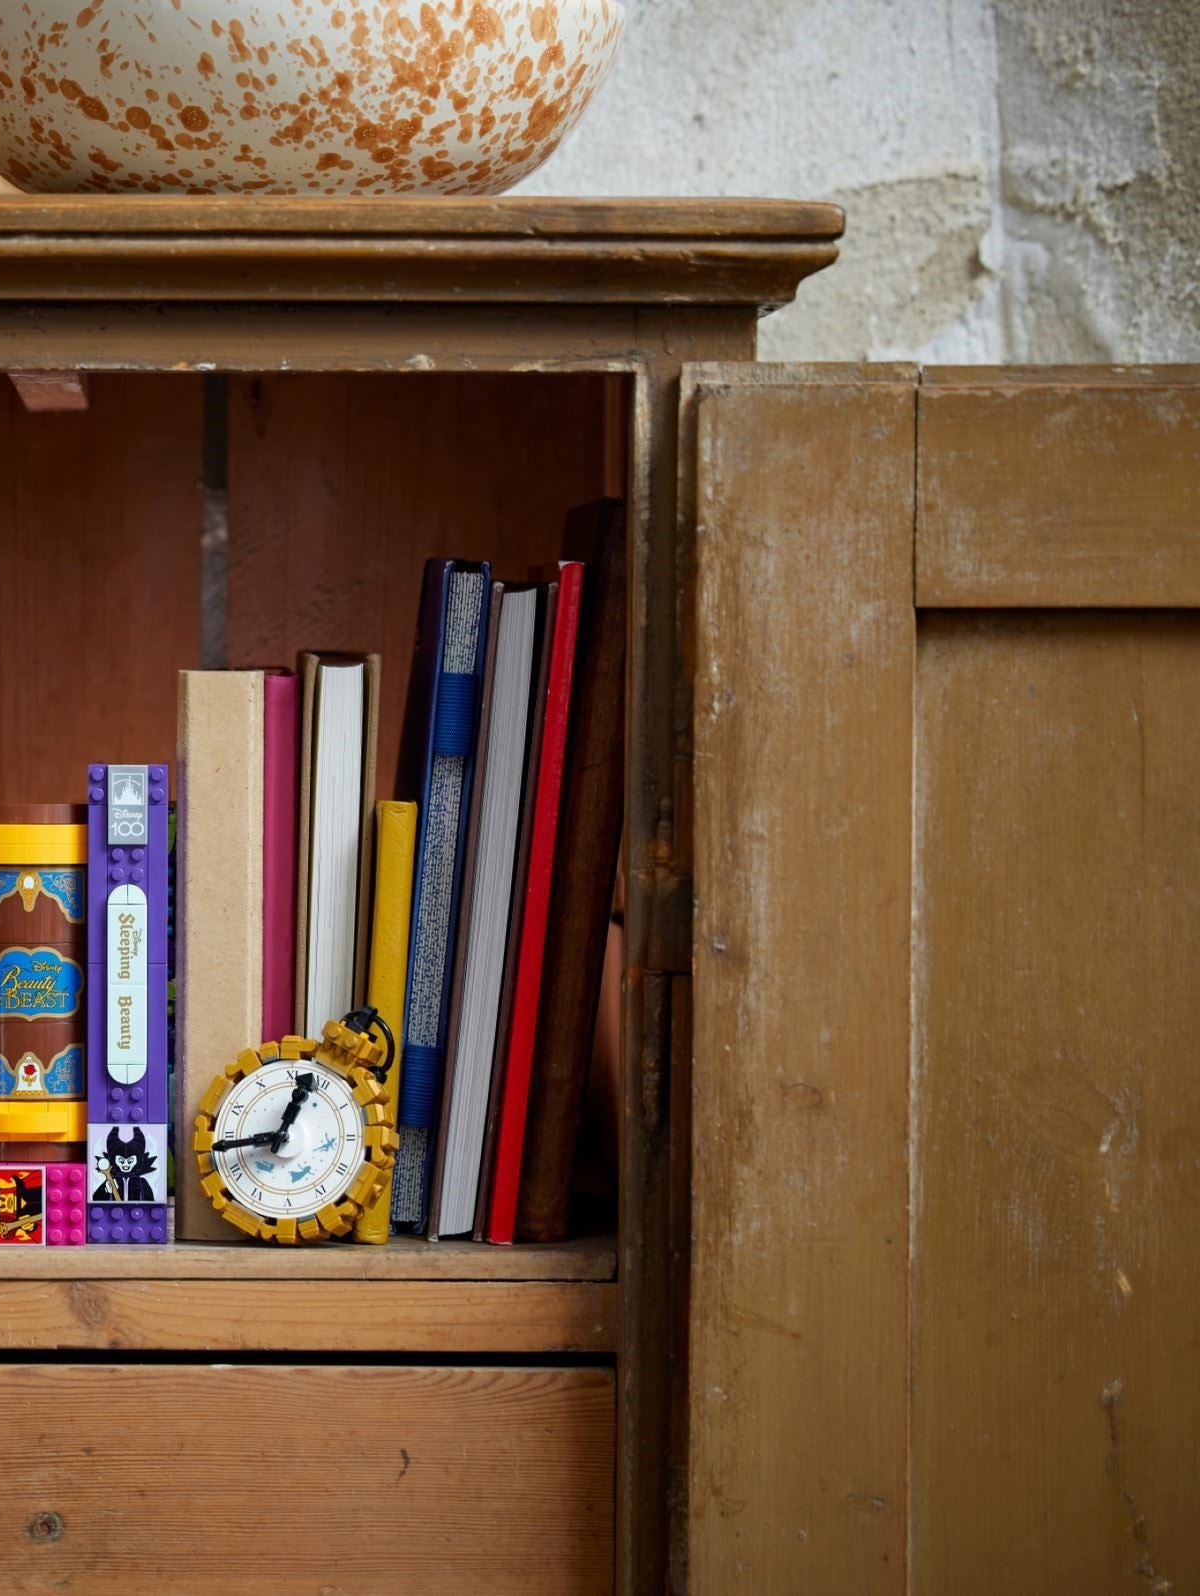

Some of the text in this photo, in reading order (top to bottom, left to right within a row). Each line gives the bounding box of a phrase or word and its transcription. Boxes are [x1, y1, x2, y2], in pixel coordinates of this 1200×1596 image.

[112, 808, 143, 822] Disney
[111, 821, 144, 836] 100
[133, 928, 142, 957] Disney
[32, 960, 62, 973] Disney
[0, 964, 56, 998] Beauty
[117, 912, 135, 1050] Sleeping Beauty
[2, 988, 69, 1009] BEAST
[255, 1080, 266, 1090] X
[231, 1101, 244, 1116] IX
[346, 1134, 355, 1142] II
[230, 1163, 242, 1181] VII
[336, 1162, 348, 1176] III
[250, 1188, 262, 1201] VI
[315, 1185, 327, 1198] IV
[283, 1198, 293, 1207] V
